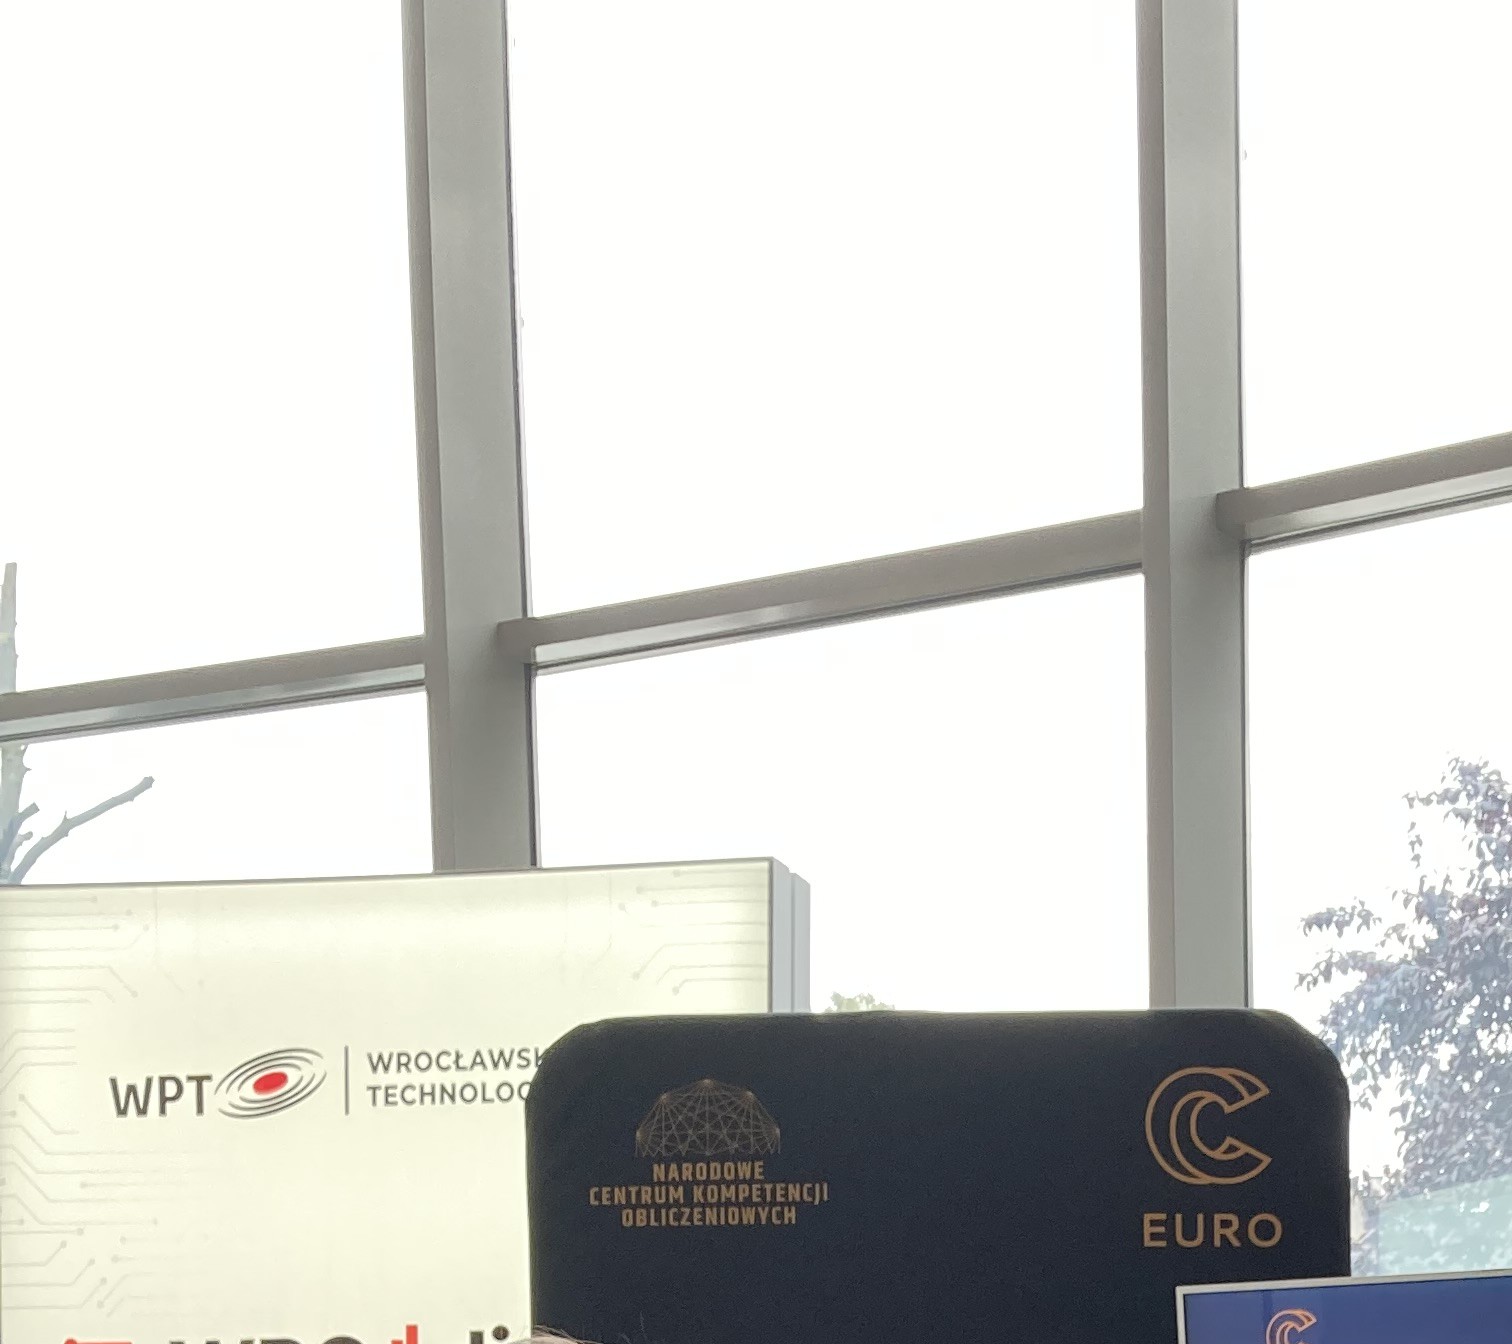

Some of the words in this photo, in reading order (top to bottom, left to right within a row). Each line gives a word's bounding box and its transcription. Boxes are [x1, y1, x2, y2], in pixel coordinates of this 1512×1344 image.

[109, 1075, 213, 1118] WPT
[653, 1160, 765, 1182] NARODOWE
[590, 1185, 684, 1205] CENTRUM
[692, 1182, 830, 1205] KOMPETENCJI
[621, 1206, 797, 1227] OBLICZENIOWYCH
[1143, 1212, 1283, 1248] EURO
